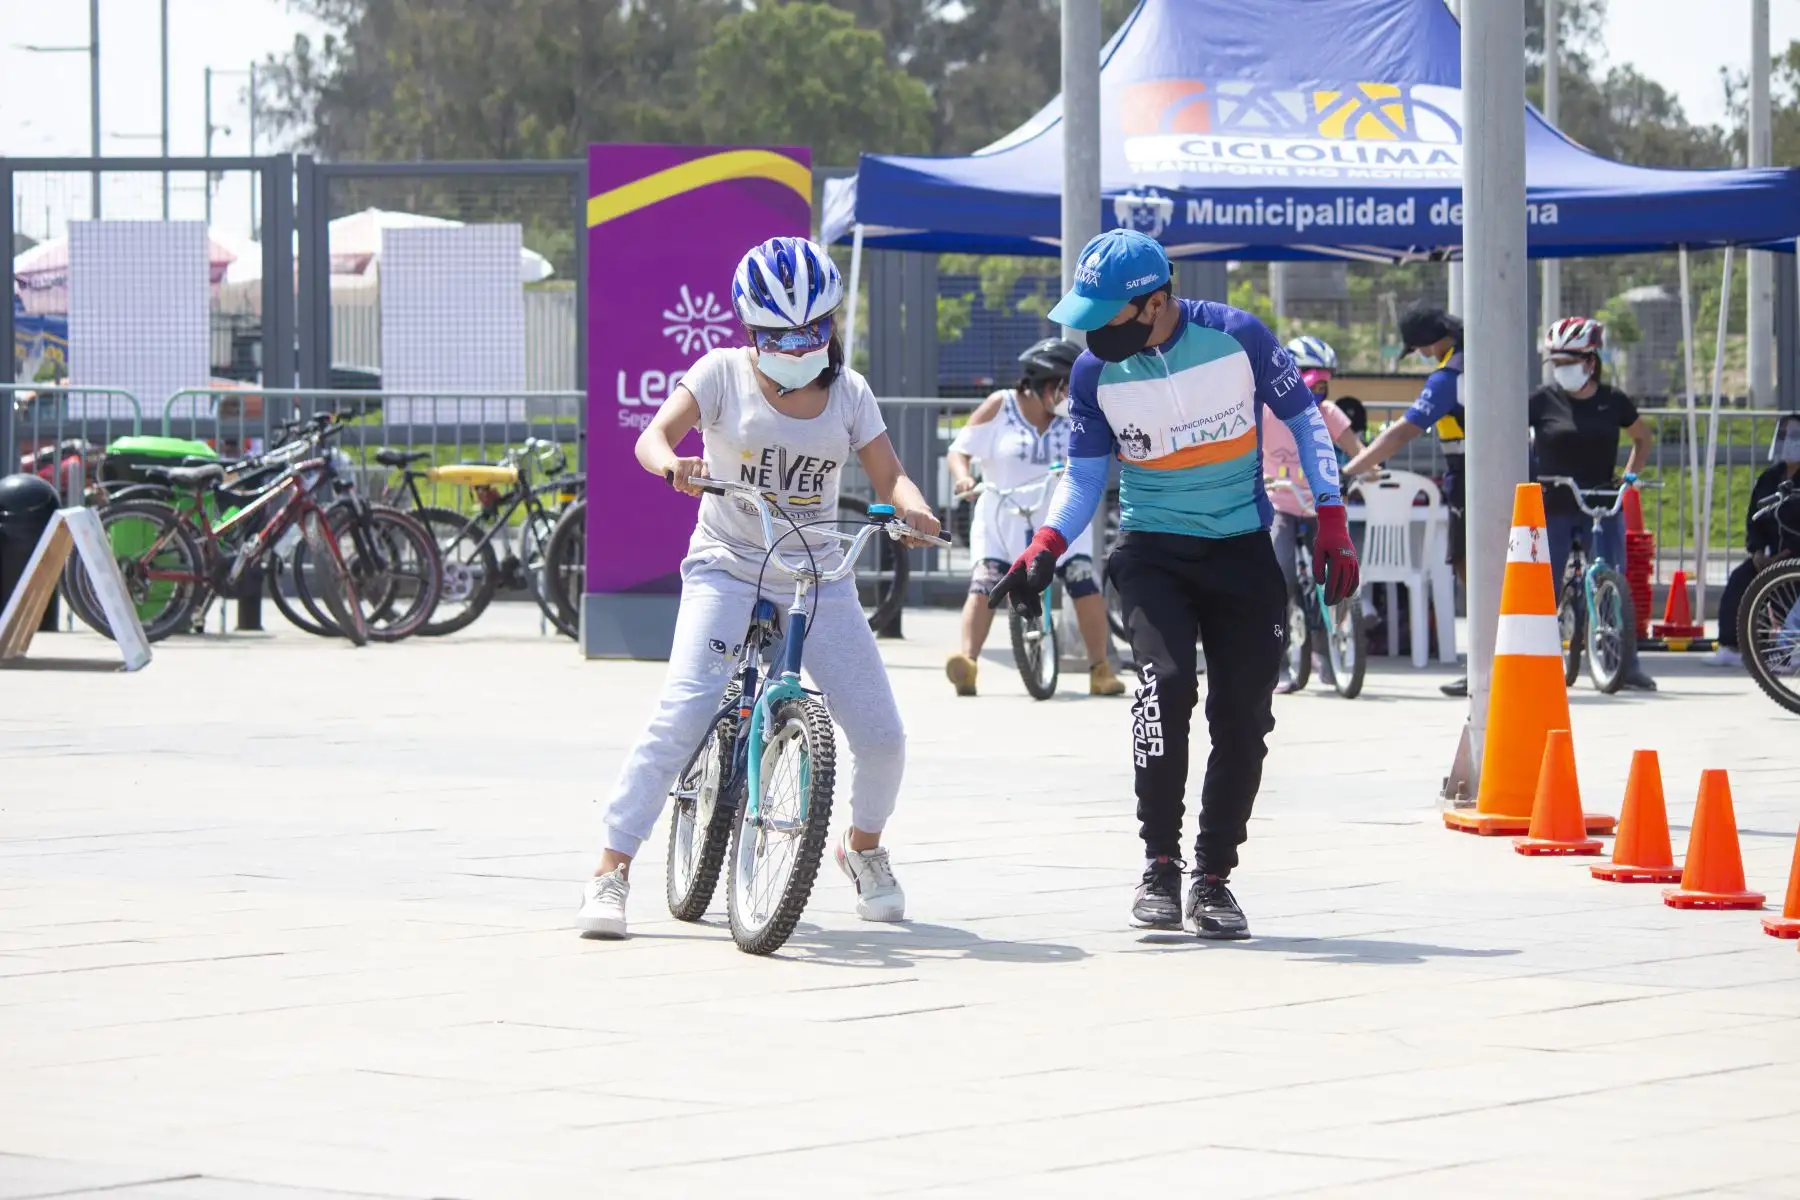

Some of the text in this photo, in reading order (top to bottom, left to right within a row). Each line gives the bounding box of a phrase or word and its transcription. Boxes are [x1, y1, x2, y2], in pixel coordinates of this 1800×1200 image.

[1179, 140, 1459, 166] CICLOLIMA
[1296, 166, 1340, 178] NO
[1186, 197, 1463, 232] Municipalidad de
[1170, 400, 1245, 433] MUNICIPALIDAD DE
[1142, 662, 1164, 757] UNDER
